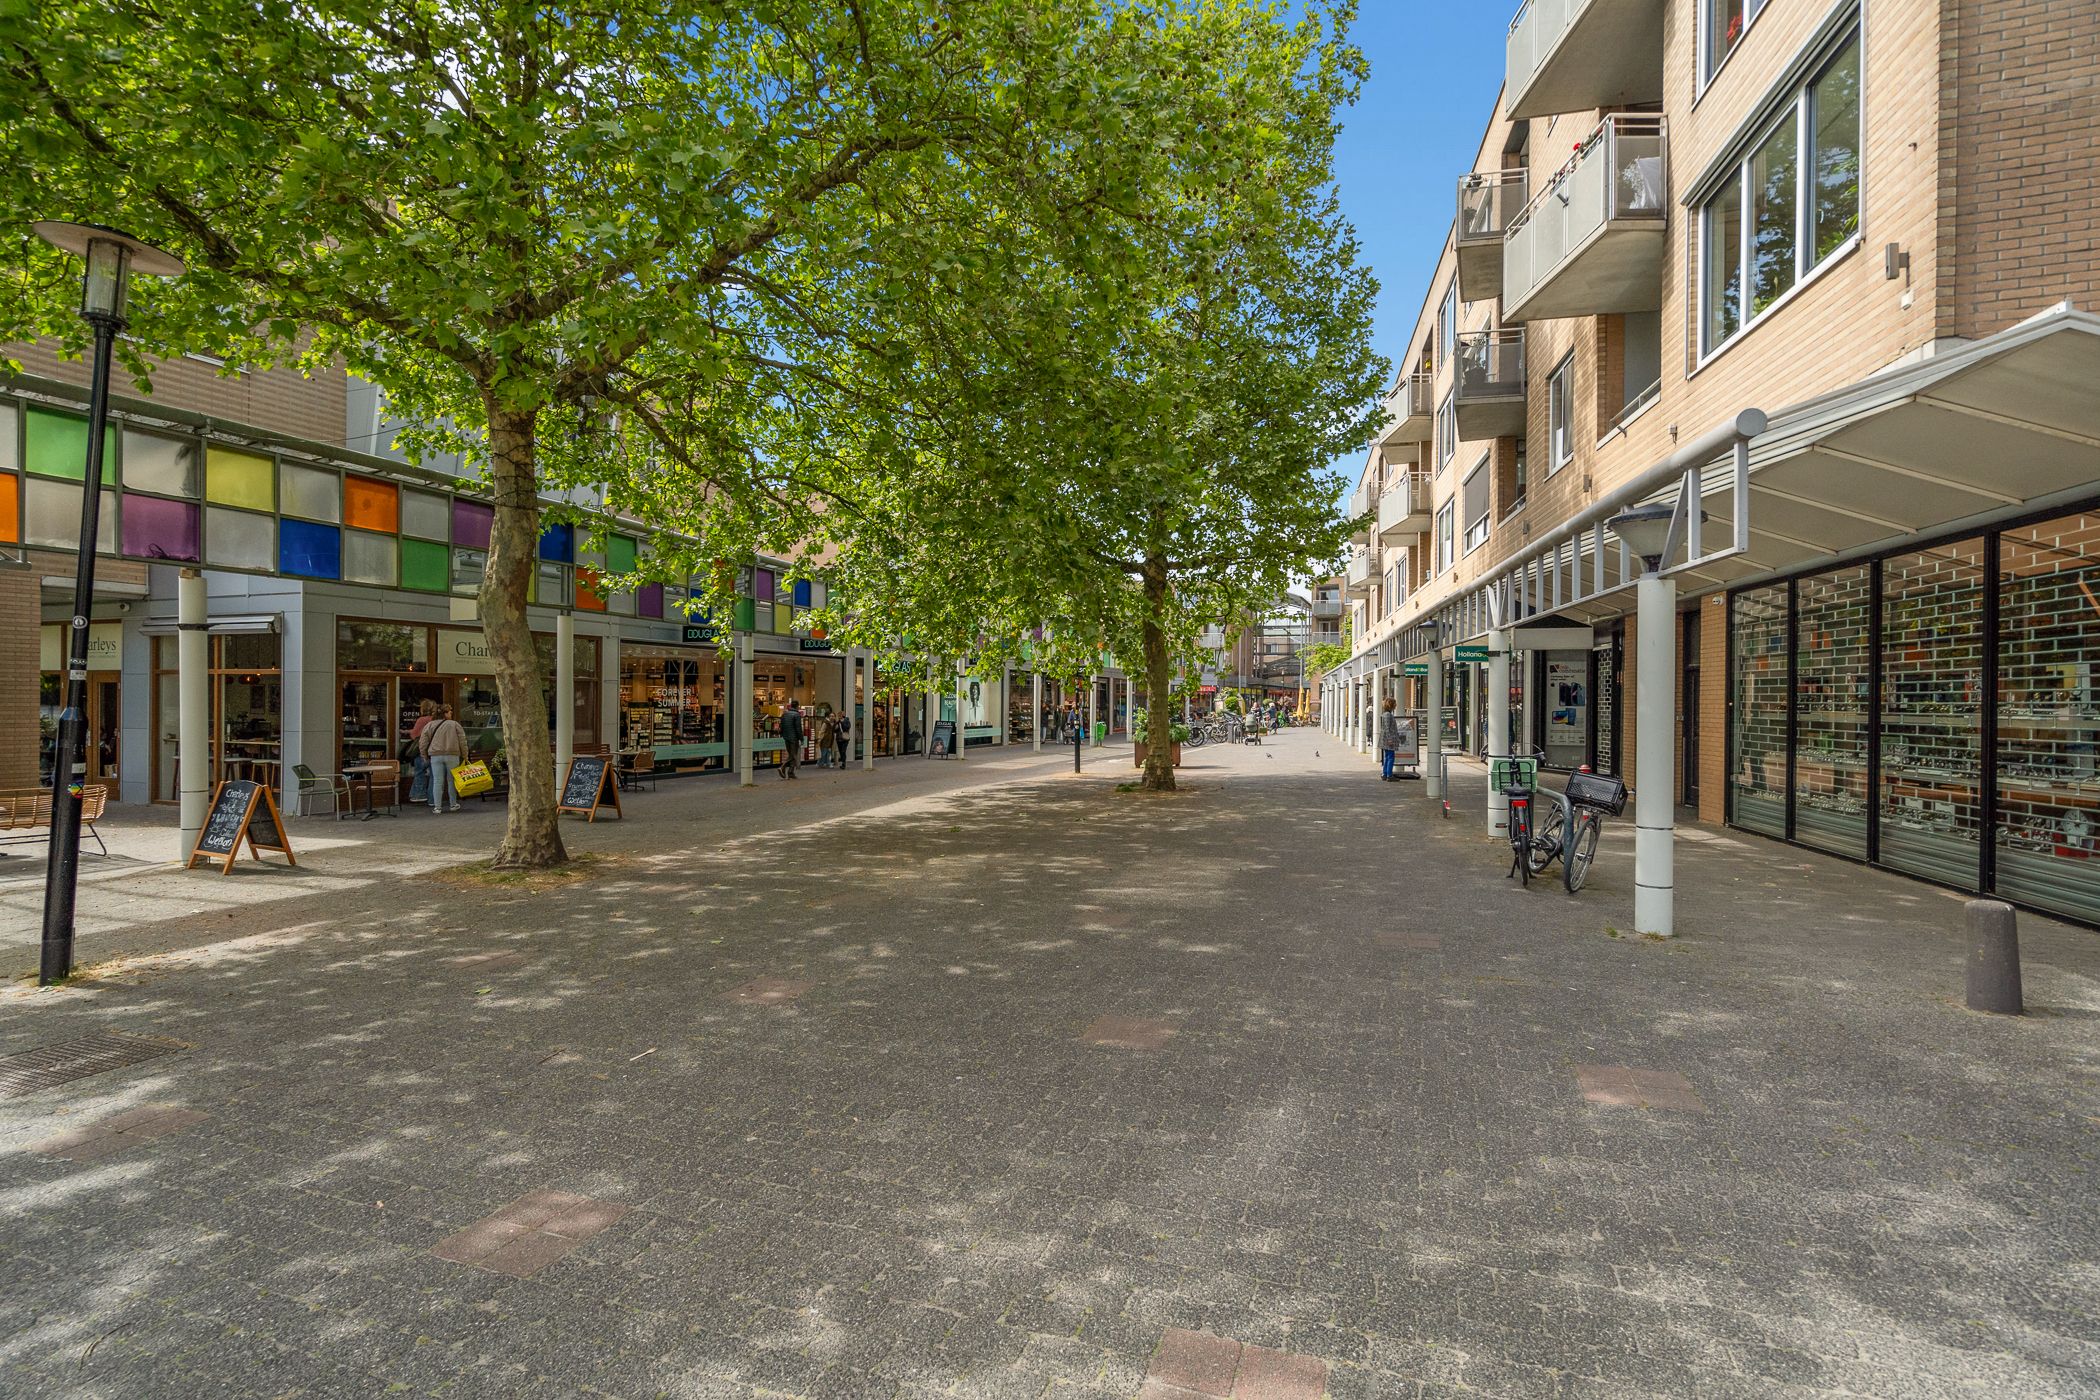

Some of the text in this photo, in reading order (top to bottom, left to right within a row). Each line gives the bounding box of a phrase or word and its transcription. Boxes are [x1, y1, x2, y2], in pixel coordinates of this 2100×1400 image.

[688, 629, 720, 639] DOUGLA
[88, 637, 116, 654] arleys
[804, 640, 832, 648] DOUGLA
[657, 688, 692, 697] FOREVER
[658, 698, 691, 707] SUMMER
